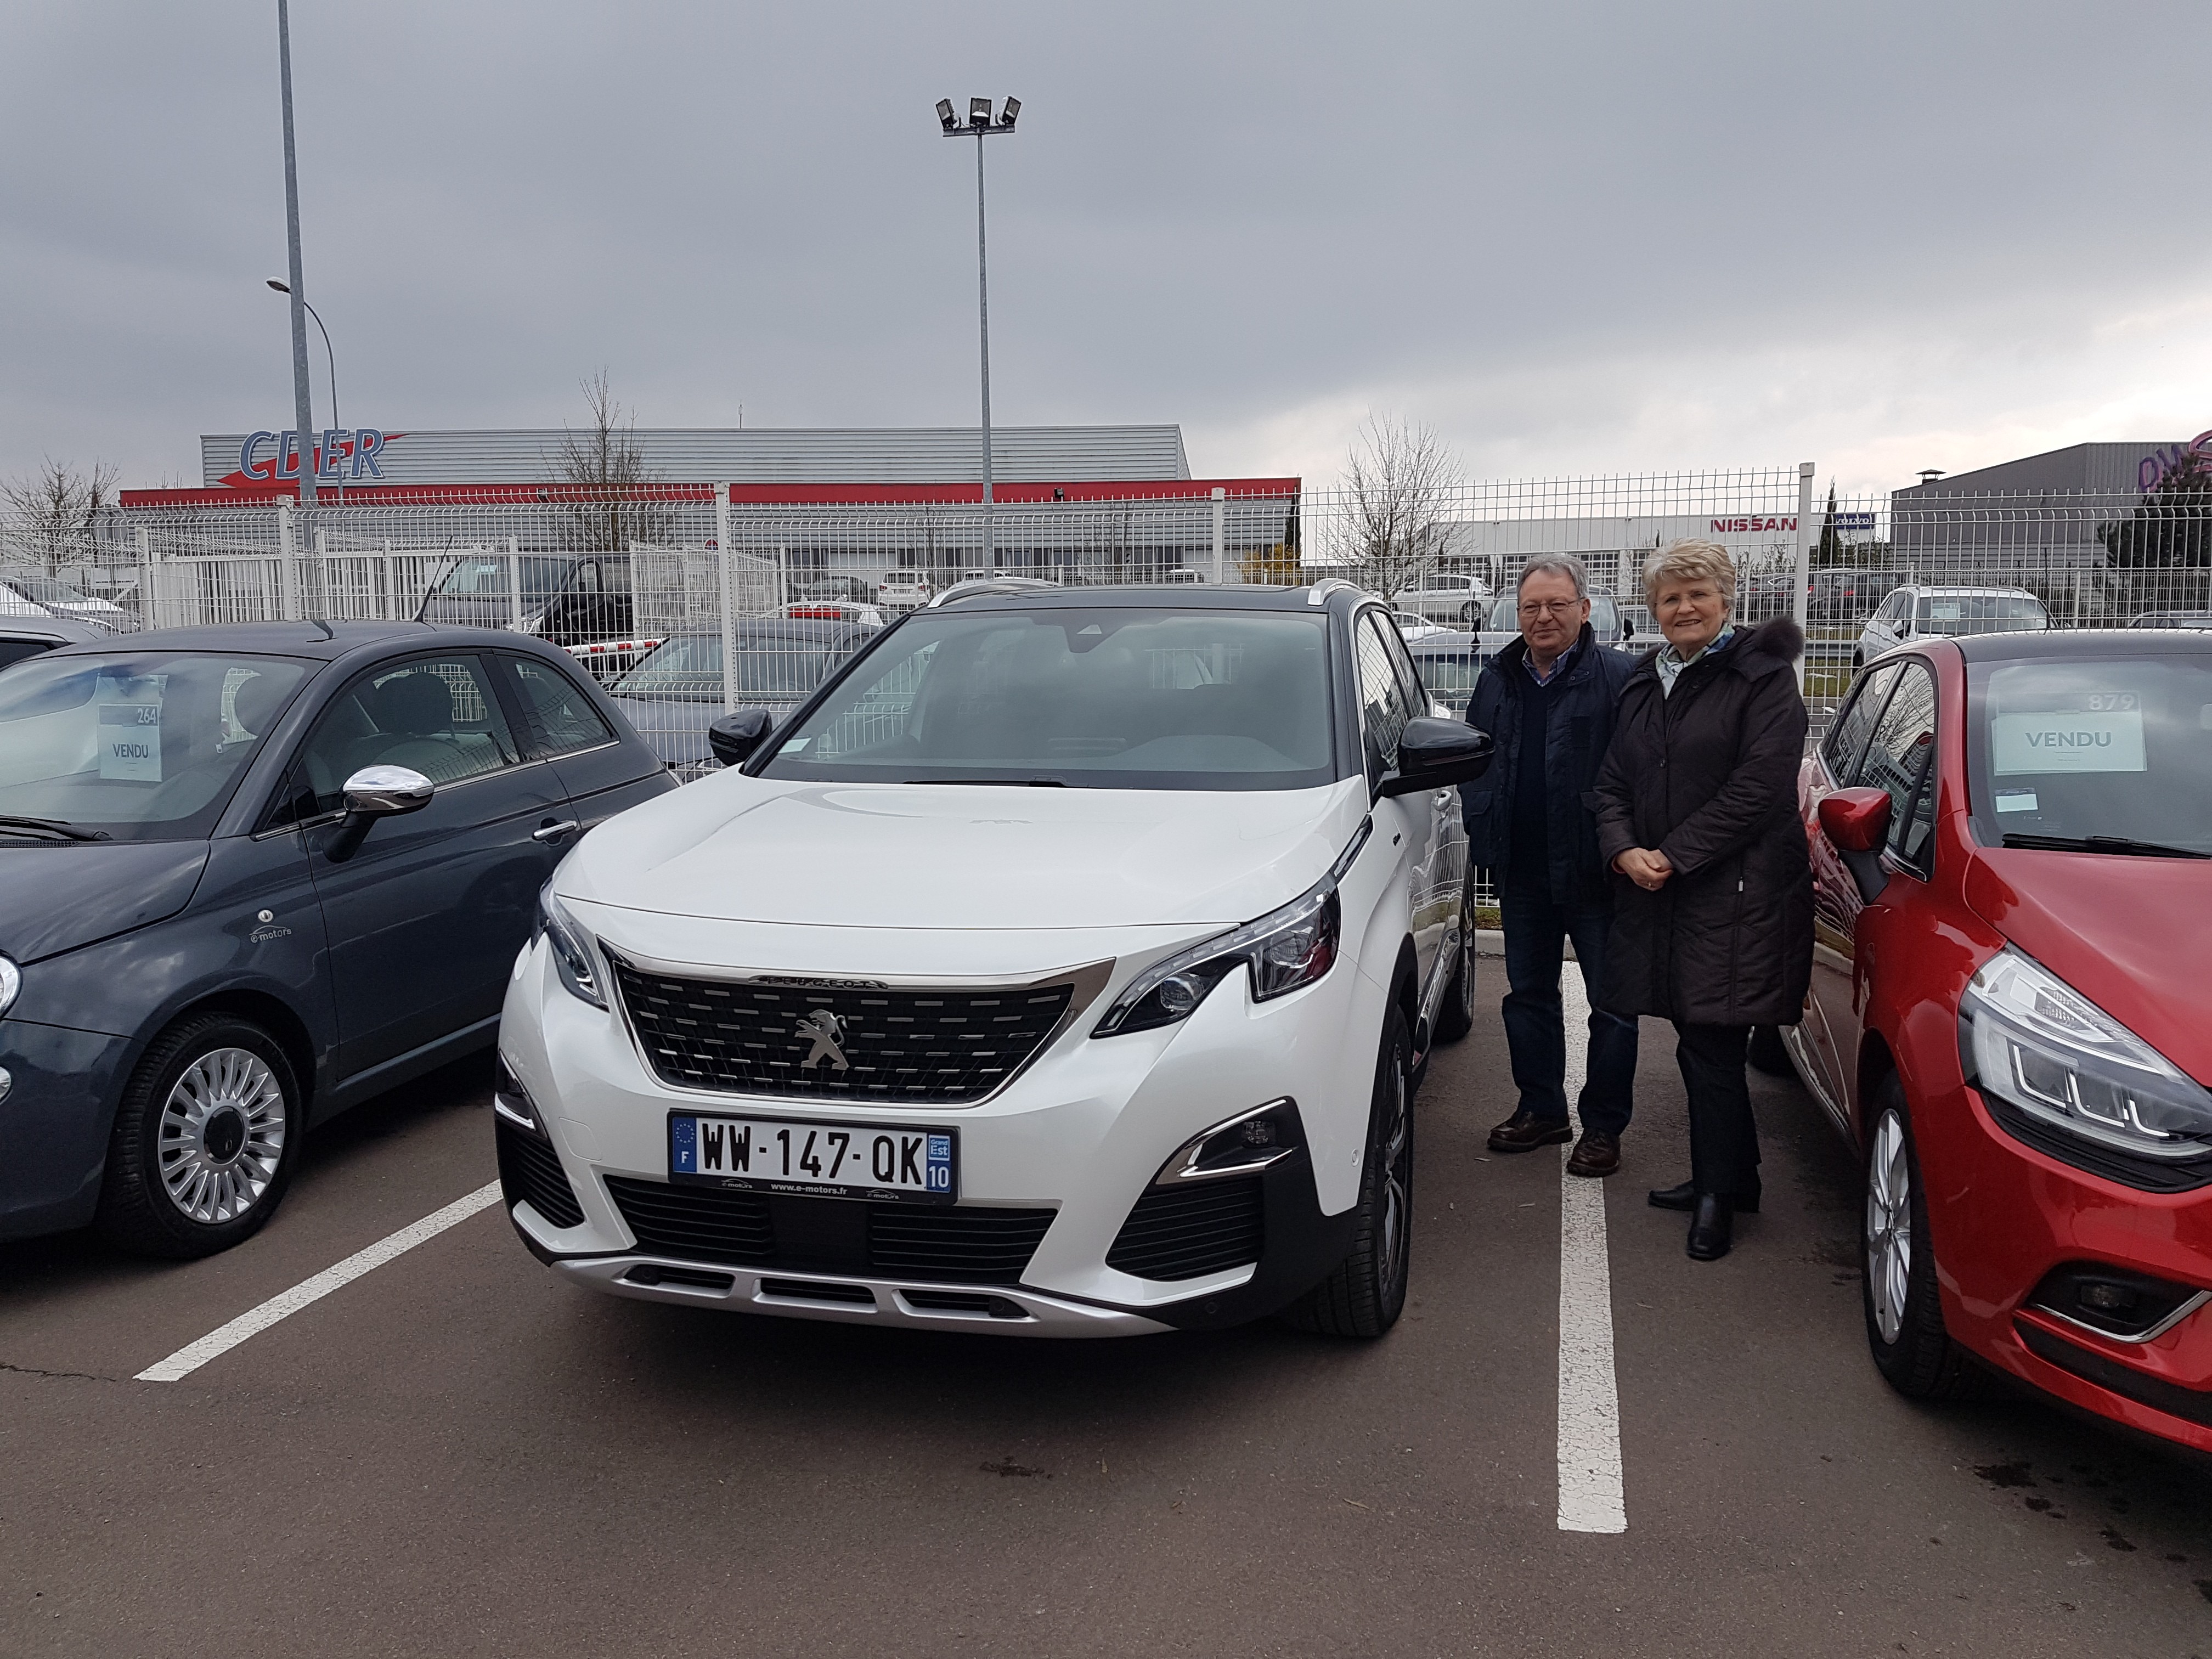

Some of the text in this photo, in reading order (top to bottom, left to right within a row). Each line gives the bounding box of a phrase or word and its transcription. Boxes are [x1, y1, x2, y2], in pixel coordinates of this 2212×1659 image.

[239, 428, 385, 481] CDER
[1711, 518, 1797, 533] NISSAN
[2089, 695, 2135, 710] 879
[137, 708, 156, 724] 264
[2025, 732, 2111, 747] VENDU
[112, 744, 149, 758] VENDU
[768, 976, 871, 988] PEUGEOT
[681, 1151, 689, 1164] F
[931, 1145, 947, 1156] Est
[929, 1166, 949, 1188] 10
[771, 1183, 848, 1195] www.e-motors.fr
